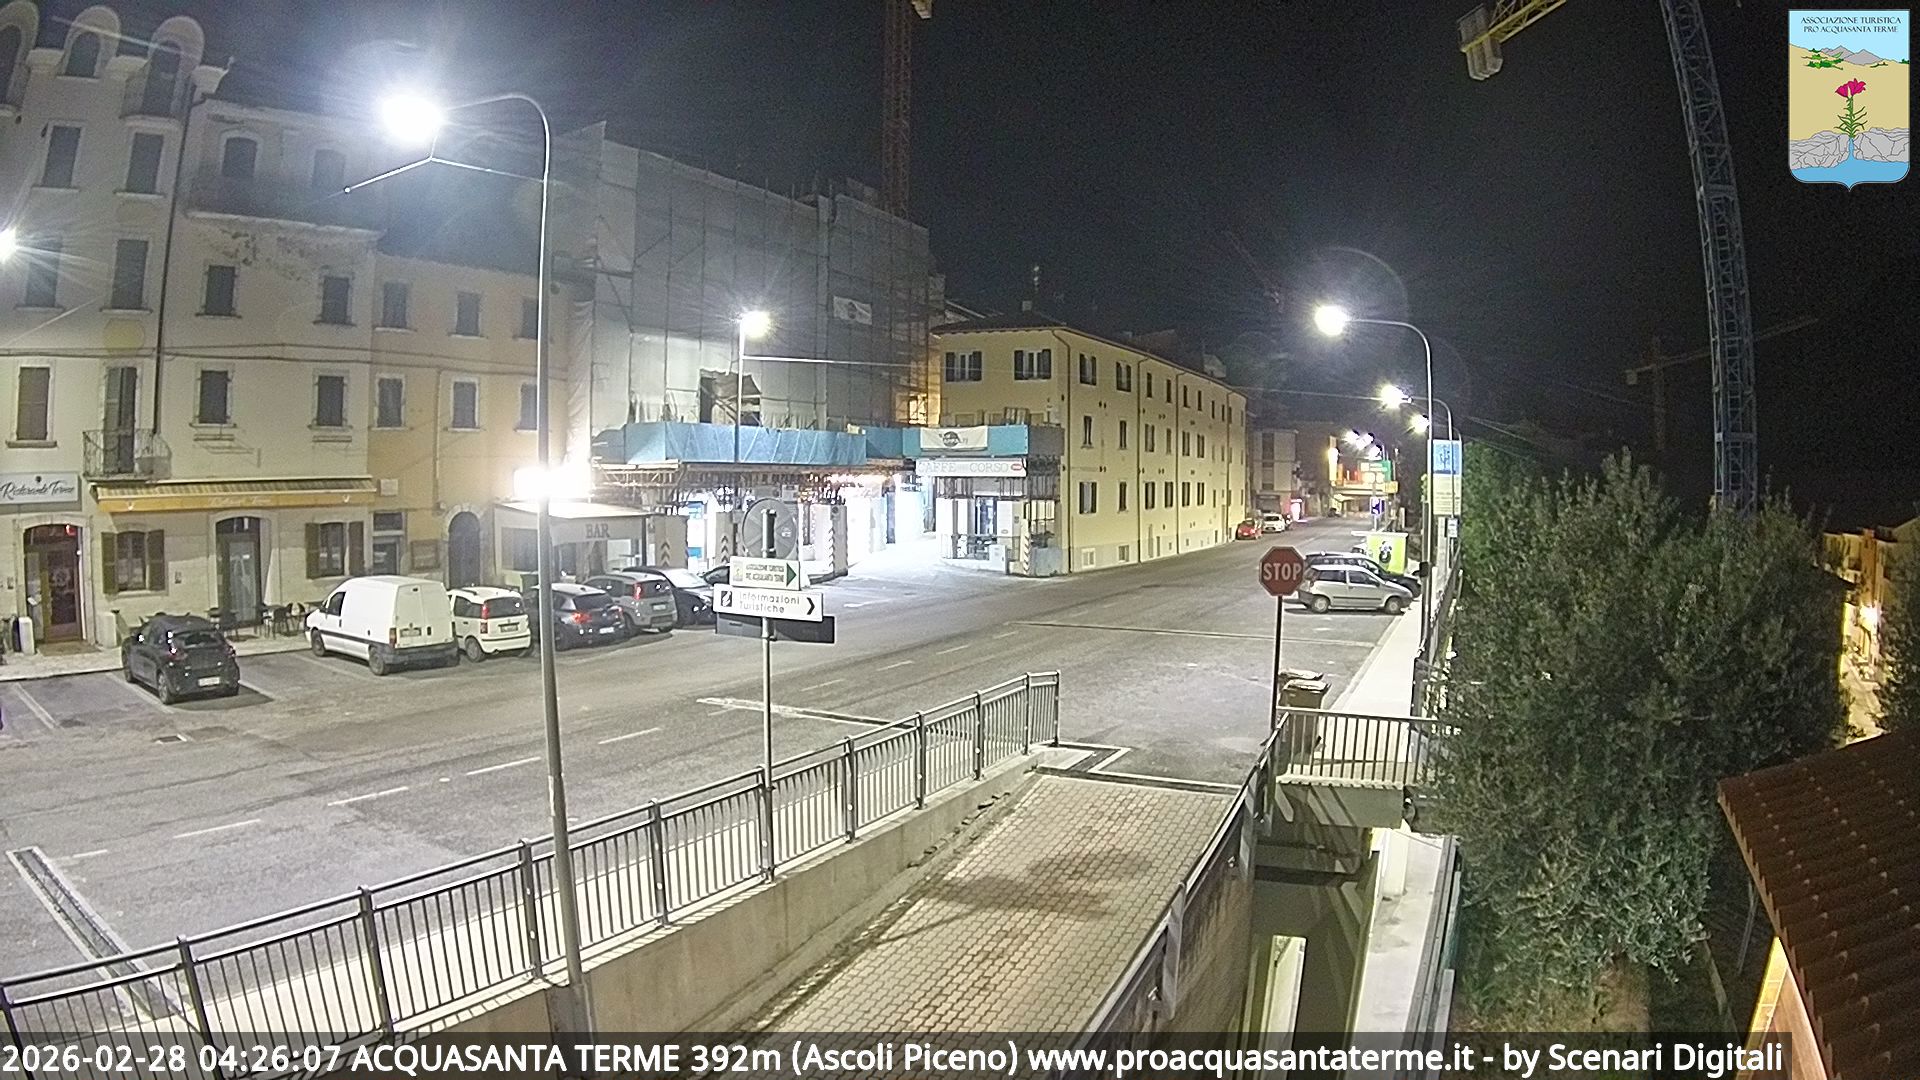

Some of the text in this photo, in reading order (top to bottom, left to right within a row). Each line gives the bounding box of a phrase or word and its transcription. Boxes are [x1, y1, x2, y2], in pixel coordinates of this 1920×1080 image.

[969, 462, 1009, 473] CORSO
[585, 523, 610, 538] BAR
[1263, 562, 1302, 580] STOP
[739, 591, 800, 605] Informazioni
[739, 600, 785, 614] Turistiche
